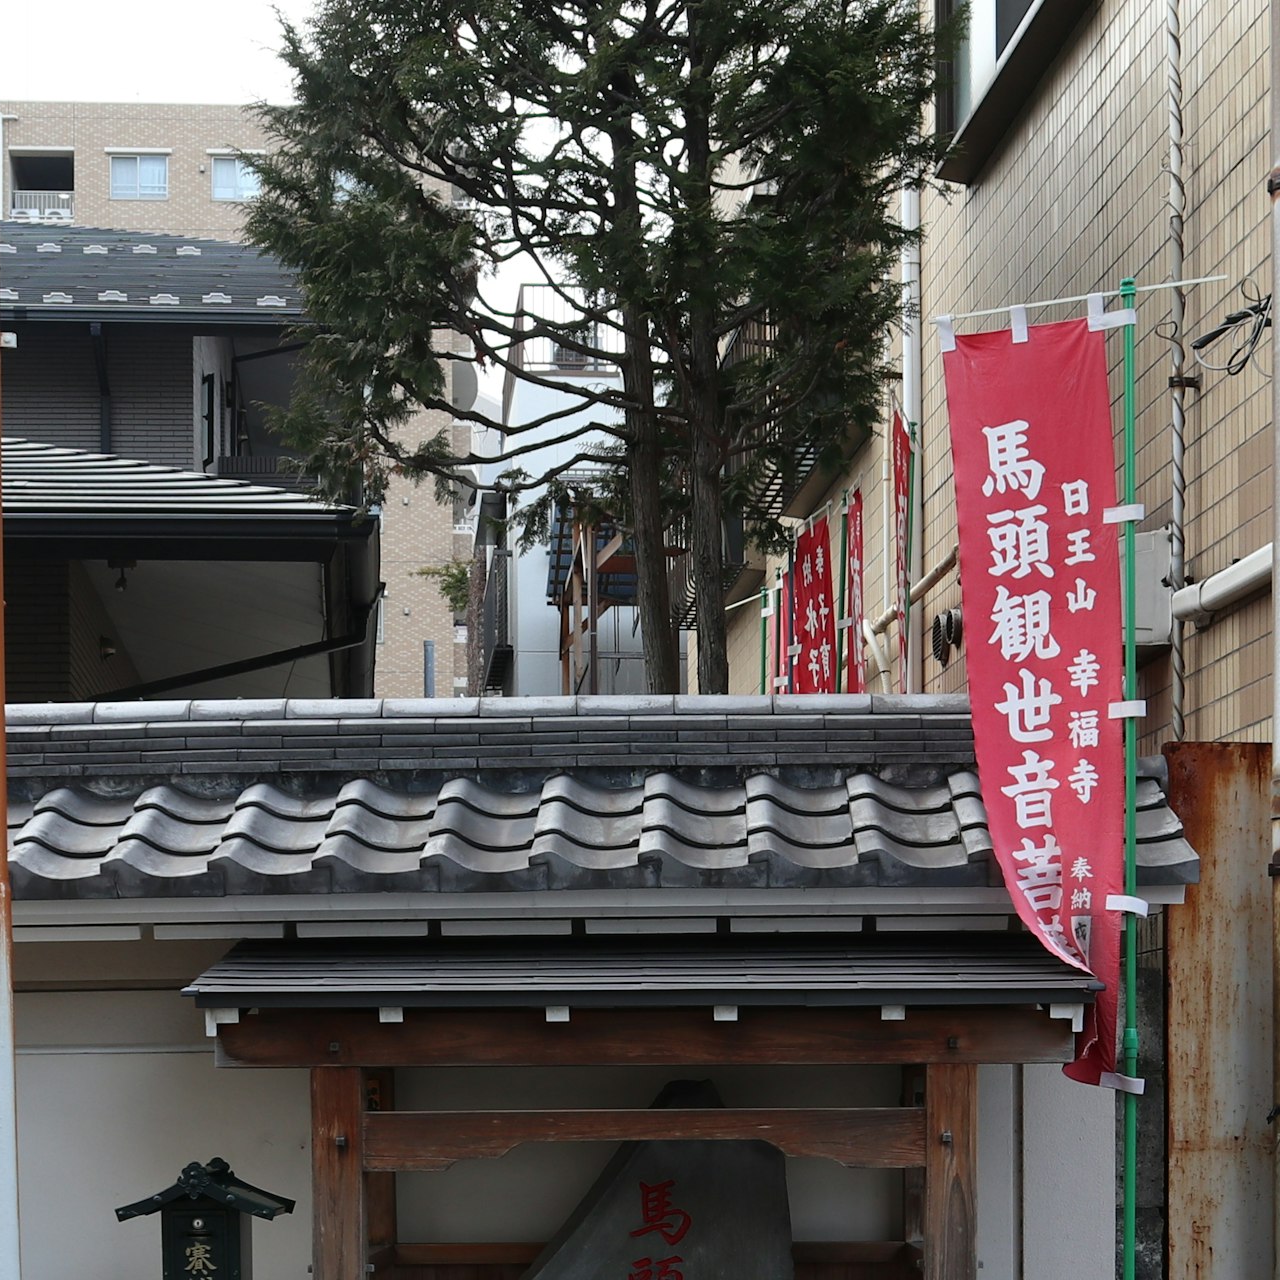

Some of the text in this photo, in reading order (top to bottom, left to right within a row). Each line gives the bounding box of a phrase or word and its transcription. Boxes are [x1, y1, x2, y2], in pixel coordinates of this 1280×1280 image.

[803, 598, 822, 693] 水子
[818, 592, 832, 693] 子育
[1061, 479, 1100, 910] 日王山 幸福寺 奉納
